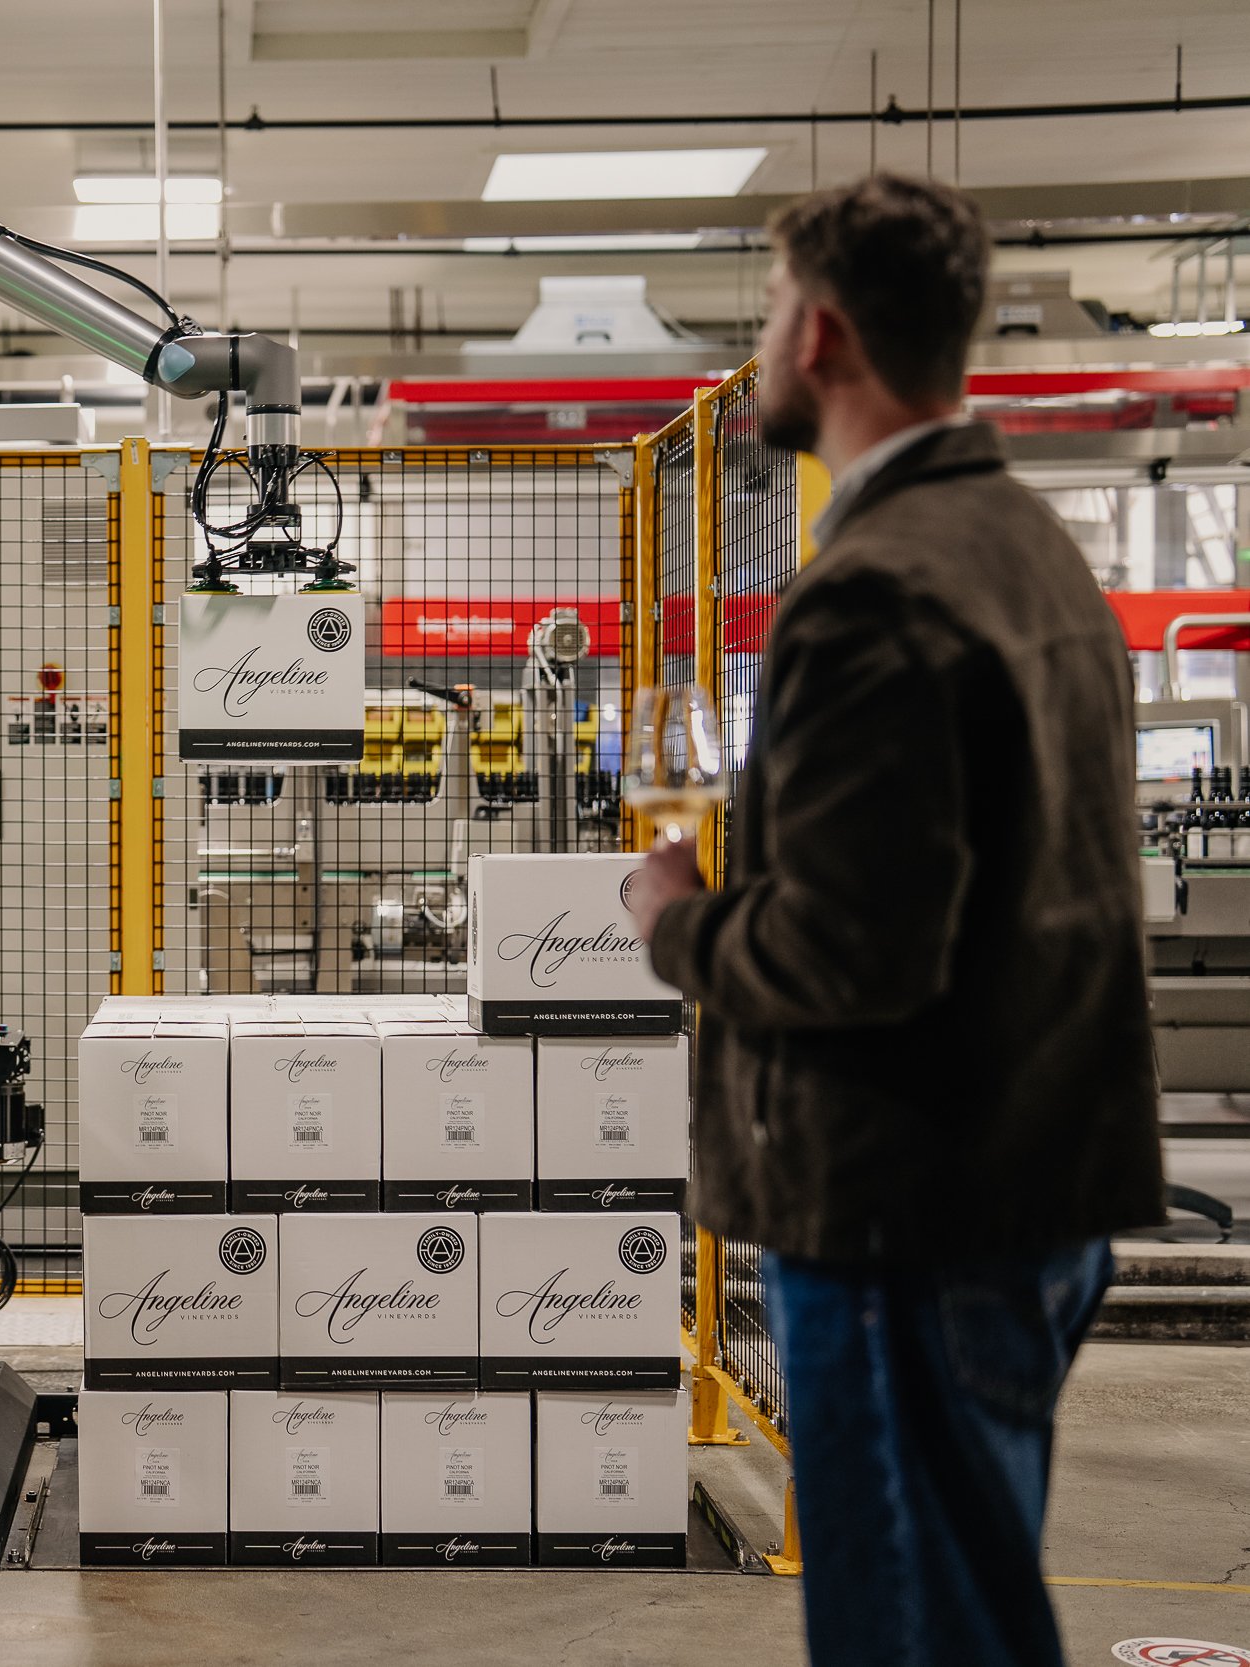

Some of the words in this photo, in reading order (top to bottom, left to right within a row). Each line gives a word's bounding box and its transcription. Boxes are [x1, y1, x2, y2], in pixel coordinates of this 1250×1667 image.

[193, 646, 329, 718] Angeline
[225, 741, 321, 749] ANGELINEVINEYARDS.COM
[497, 910, 644, 988] Angeline
[533, 1013, 635, 1021] ANGELINEVINEYARDS.COM
[120, 1050, 184, 1085] Angeline
[274, 1048, 337, 1084] Angeline
[426, 1048, 489, 1083] Angeline
[580, 1047, 644, 1082] Angeline
[131, 1185, 175, 1210] Angeline
[284, 1184, 328, 1209] Angeline
[437, 1184, 480, 1209] Angeline
[592, 1184, 636, 1208] Angeline
[99, 1269, 243, 1346] Angeline
[295, 1268, 441, 1345] Angeline
[496, 1268, 642, 1345] Angeline
[135, 1370, 236, 1378] ANGELINEVINEYARDS.COM
[331, 1369, 432, 1377] ANGELINEVINEYARDS.COM
[532, 1369, 633, 1377] ANGELINEVINEYARDS.COM
[121, 1402, 184, 1436] Angeline
[272, 1401, 335, 1436] Angeline
[424, 1401, 488, 1436] Angeline
[581, 1401, 644, 1436] Angeline
[132, 1536, 176, 1561] Angeline
[282, 1535, 326, 1560] Angeline
[436, 1537, 480, 1561] Angeline
[592, 1537, 636, 1562] Angeline
